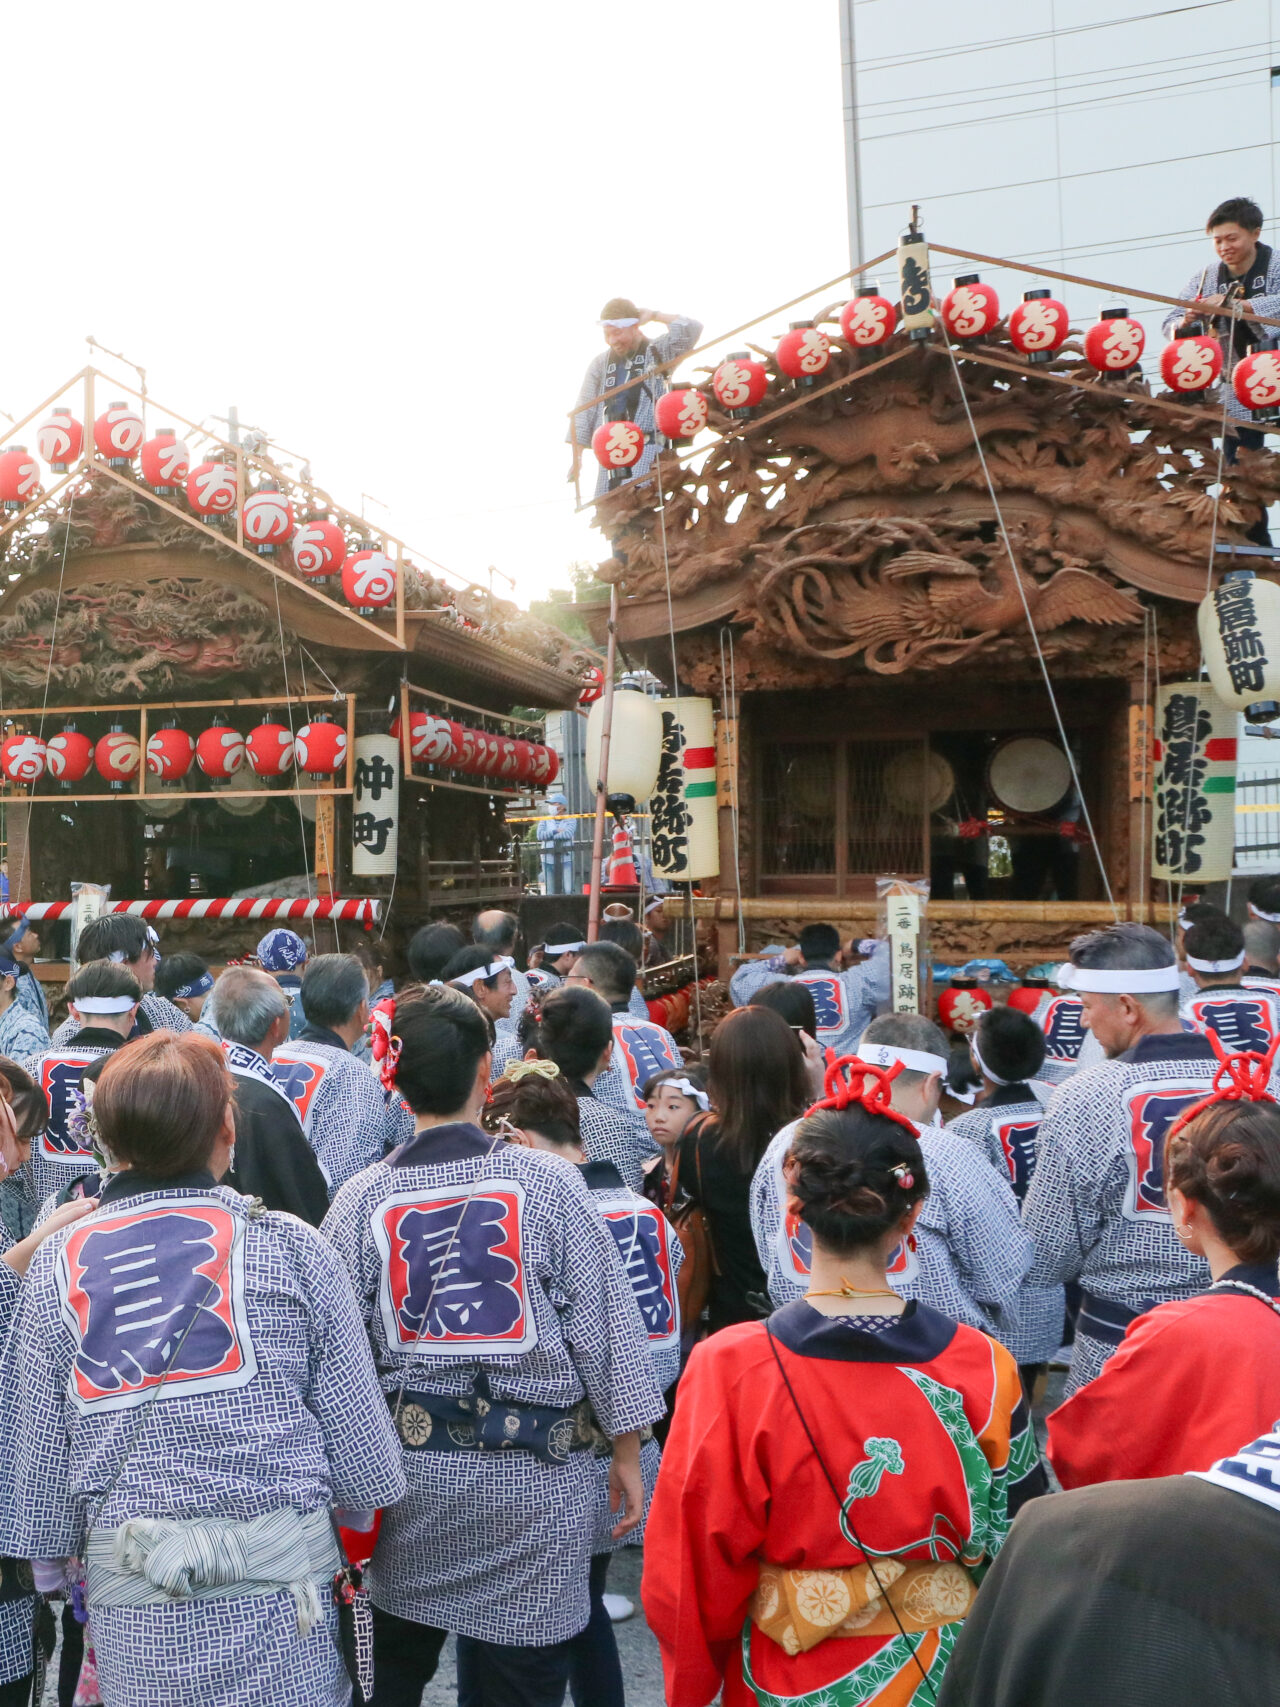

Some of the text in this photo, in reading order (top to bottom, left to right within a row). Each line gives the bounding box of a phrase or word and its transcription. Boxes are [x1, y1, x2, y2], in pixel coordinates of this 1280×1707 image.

[1213, 579, 1269, 695] 鳥居跡町
[353, 755, 395, 855] 仲町
[1155, 693, 1212, 874] 鳥居跡町
[896, 906, 911, 929] 二番
